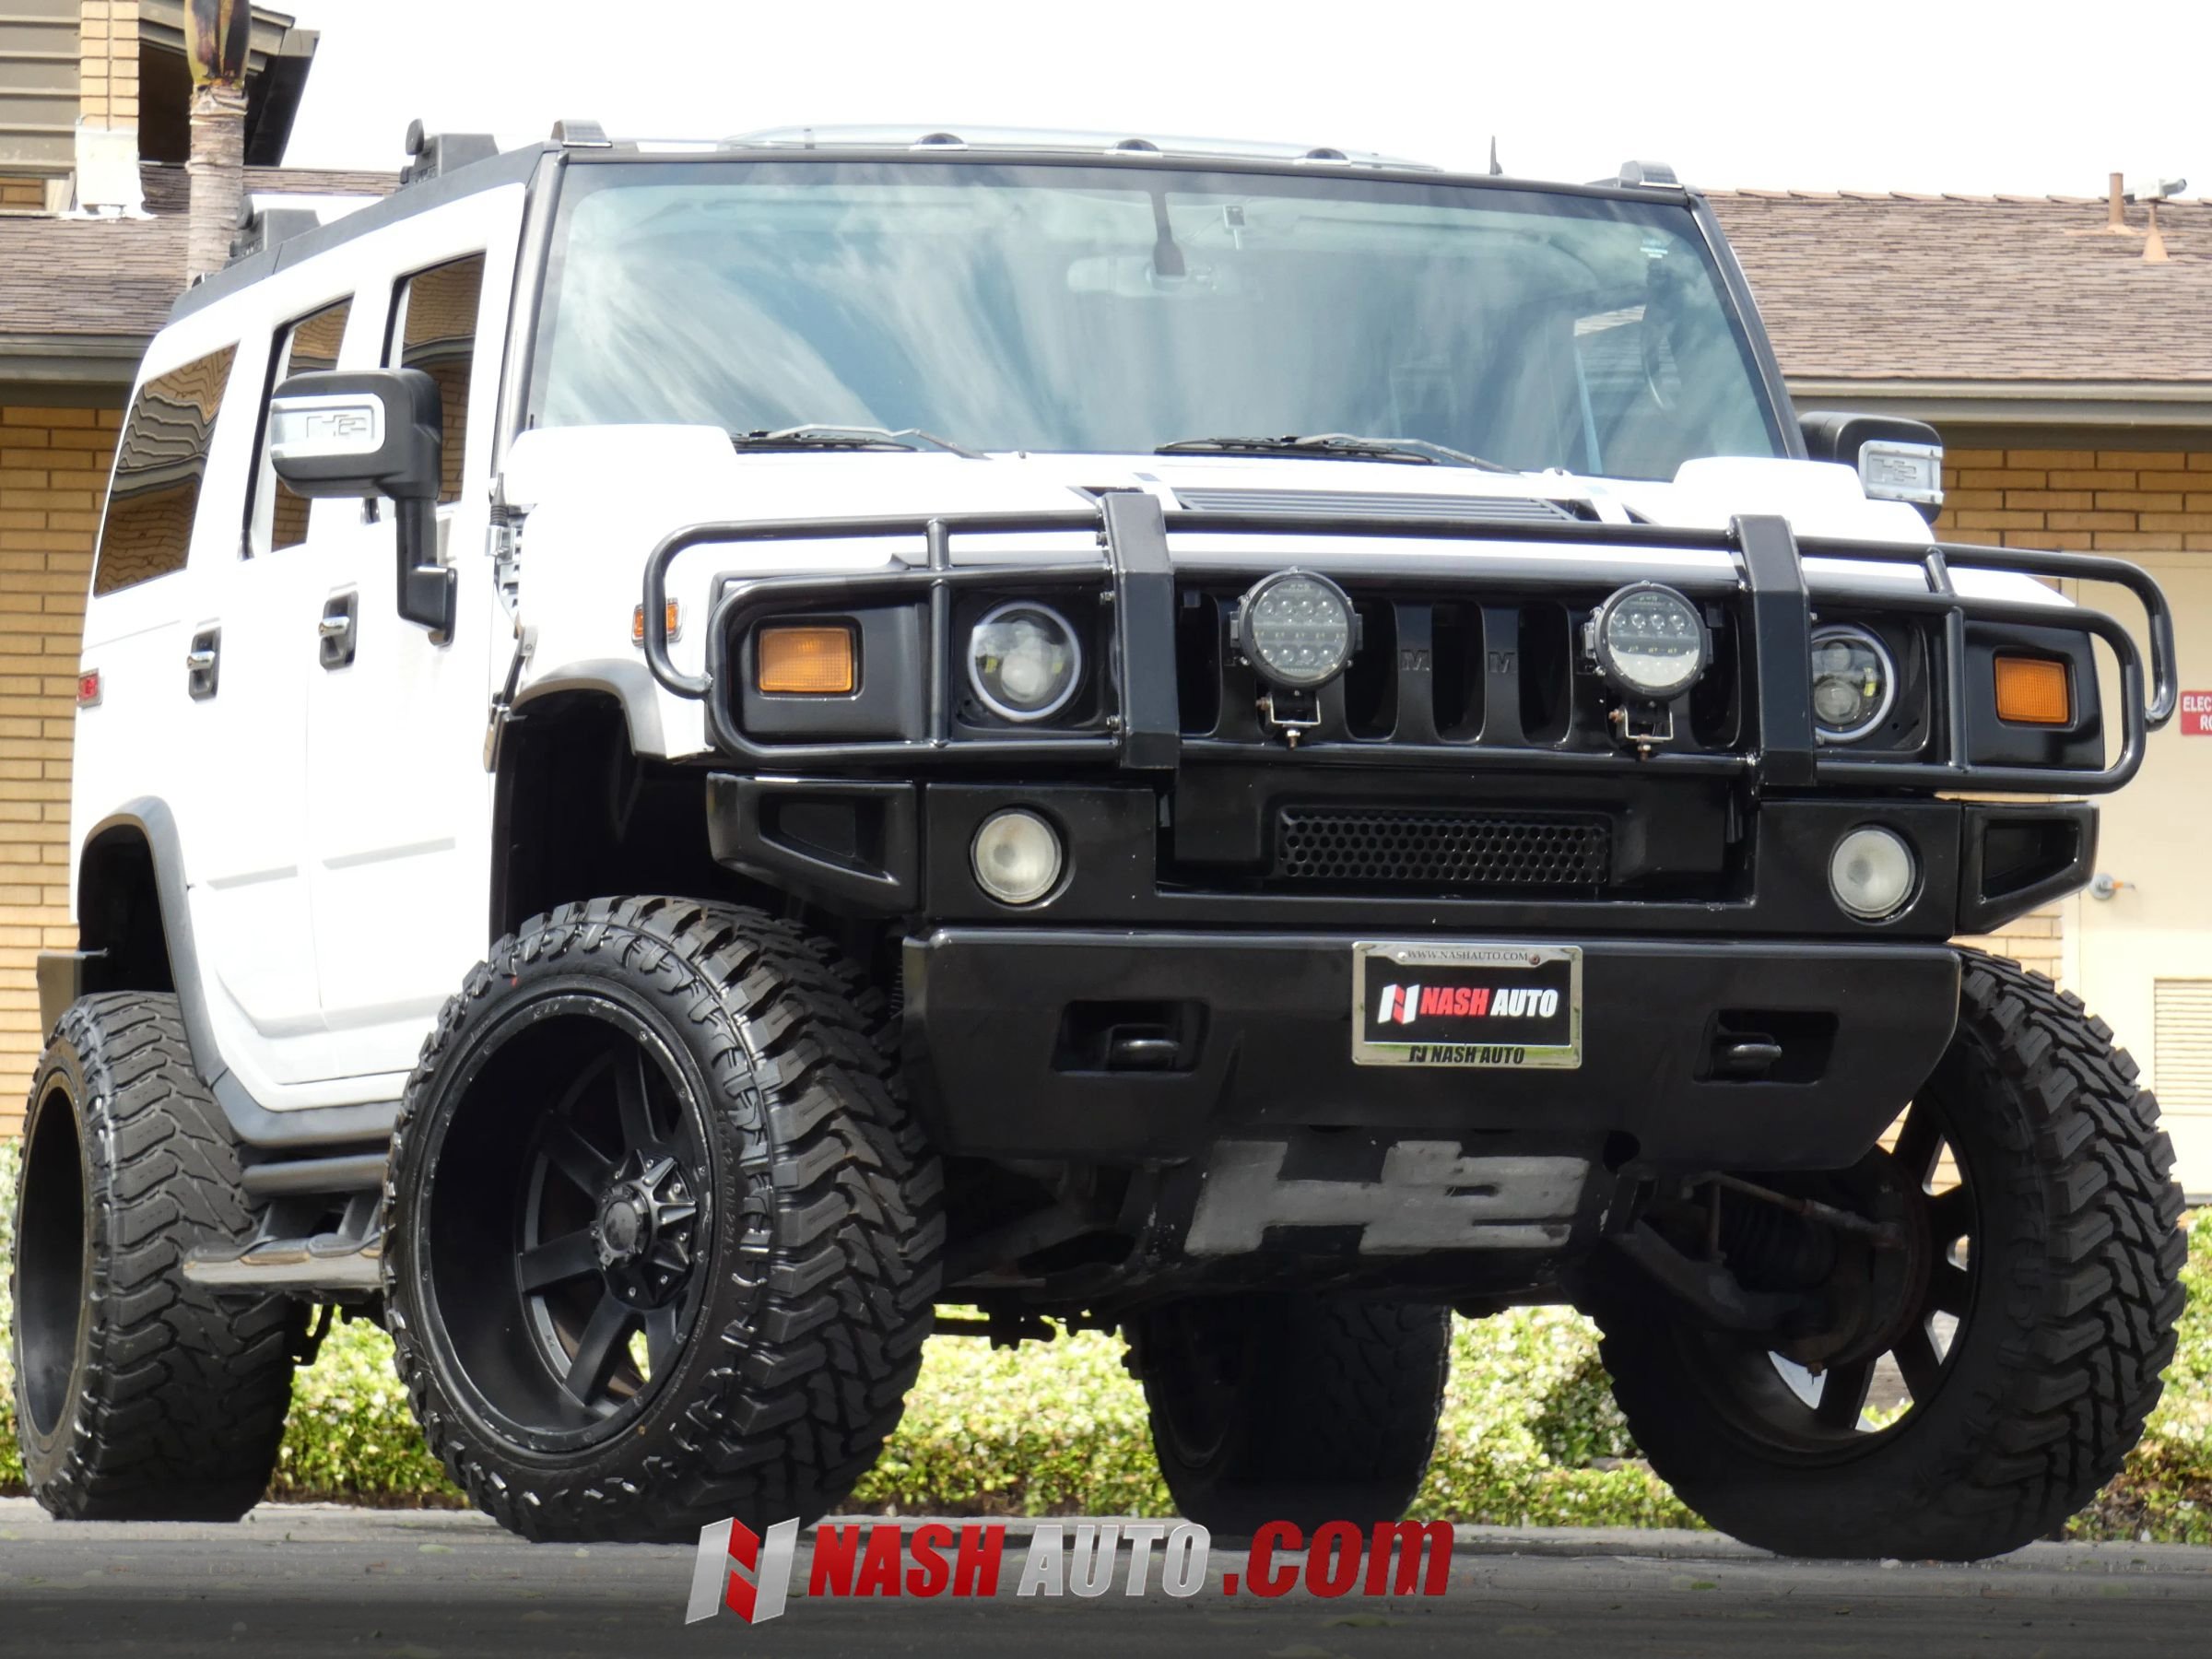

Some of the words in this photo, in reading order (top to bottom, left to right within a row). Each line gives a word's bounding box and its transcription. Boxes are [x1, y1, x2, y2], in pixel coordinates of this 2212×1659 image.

[1406, 950, 1528, 962] WWW.NASHAUTO.COM
[1419, 986, 1490, 1017] NASH
[1489, 988, 1559, 1018] AUTO
[1430, 1045, 1477, 1064] NASH
[1478, 1046, 1525, 1065] AUTO
[1183, 1139, 1590, 1255] H2
